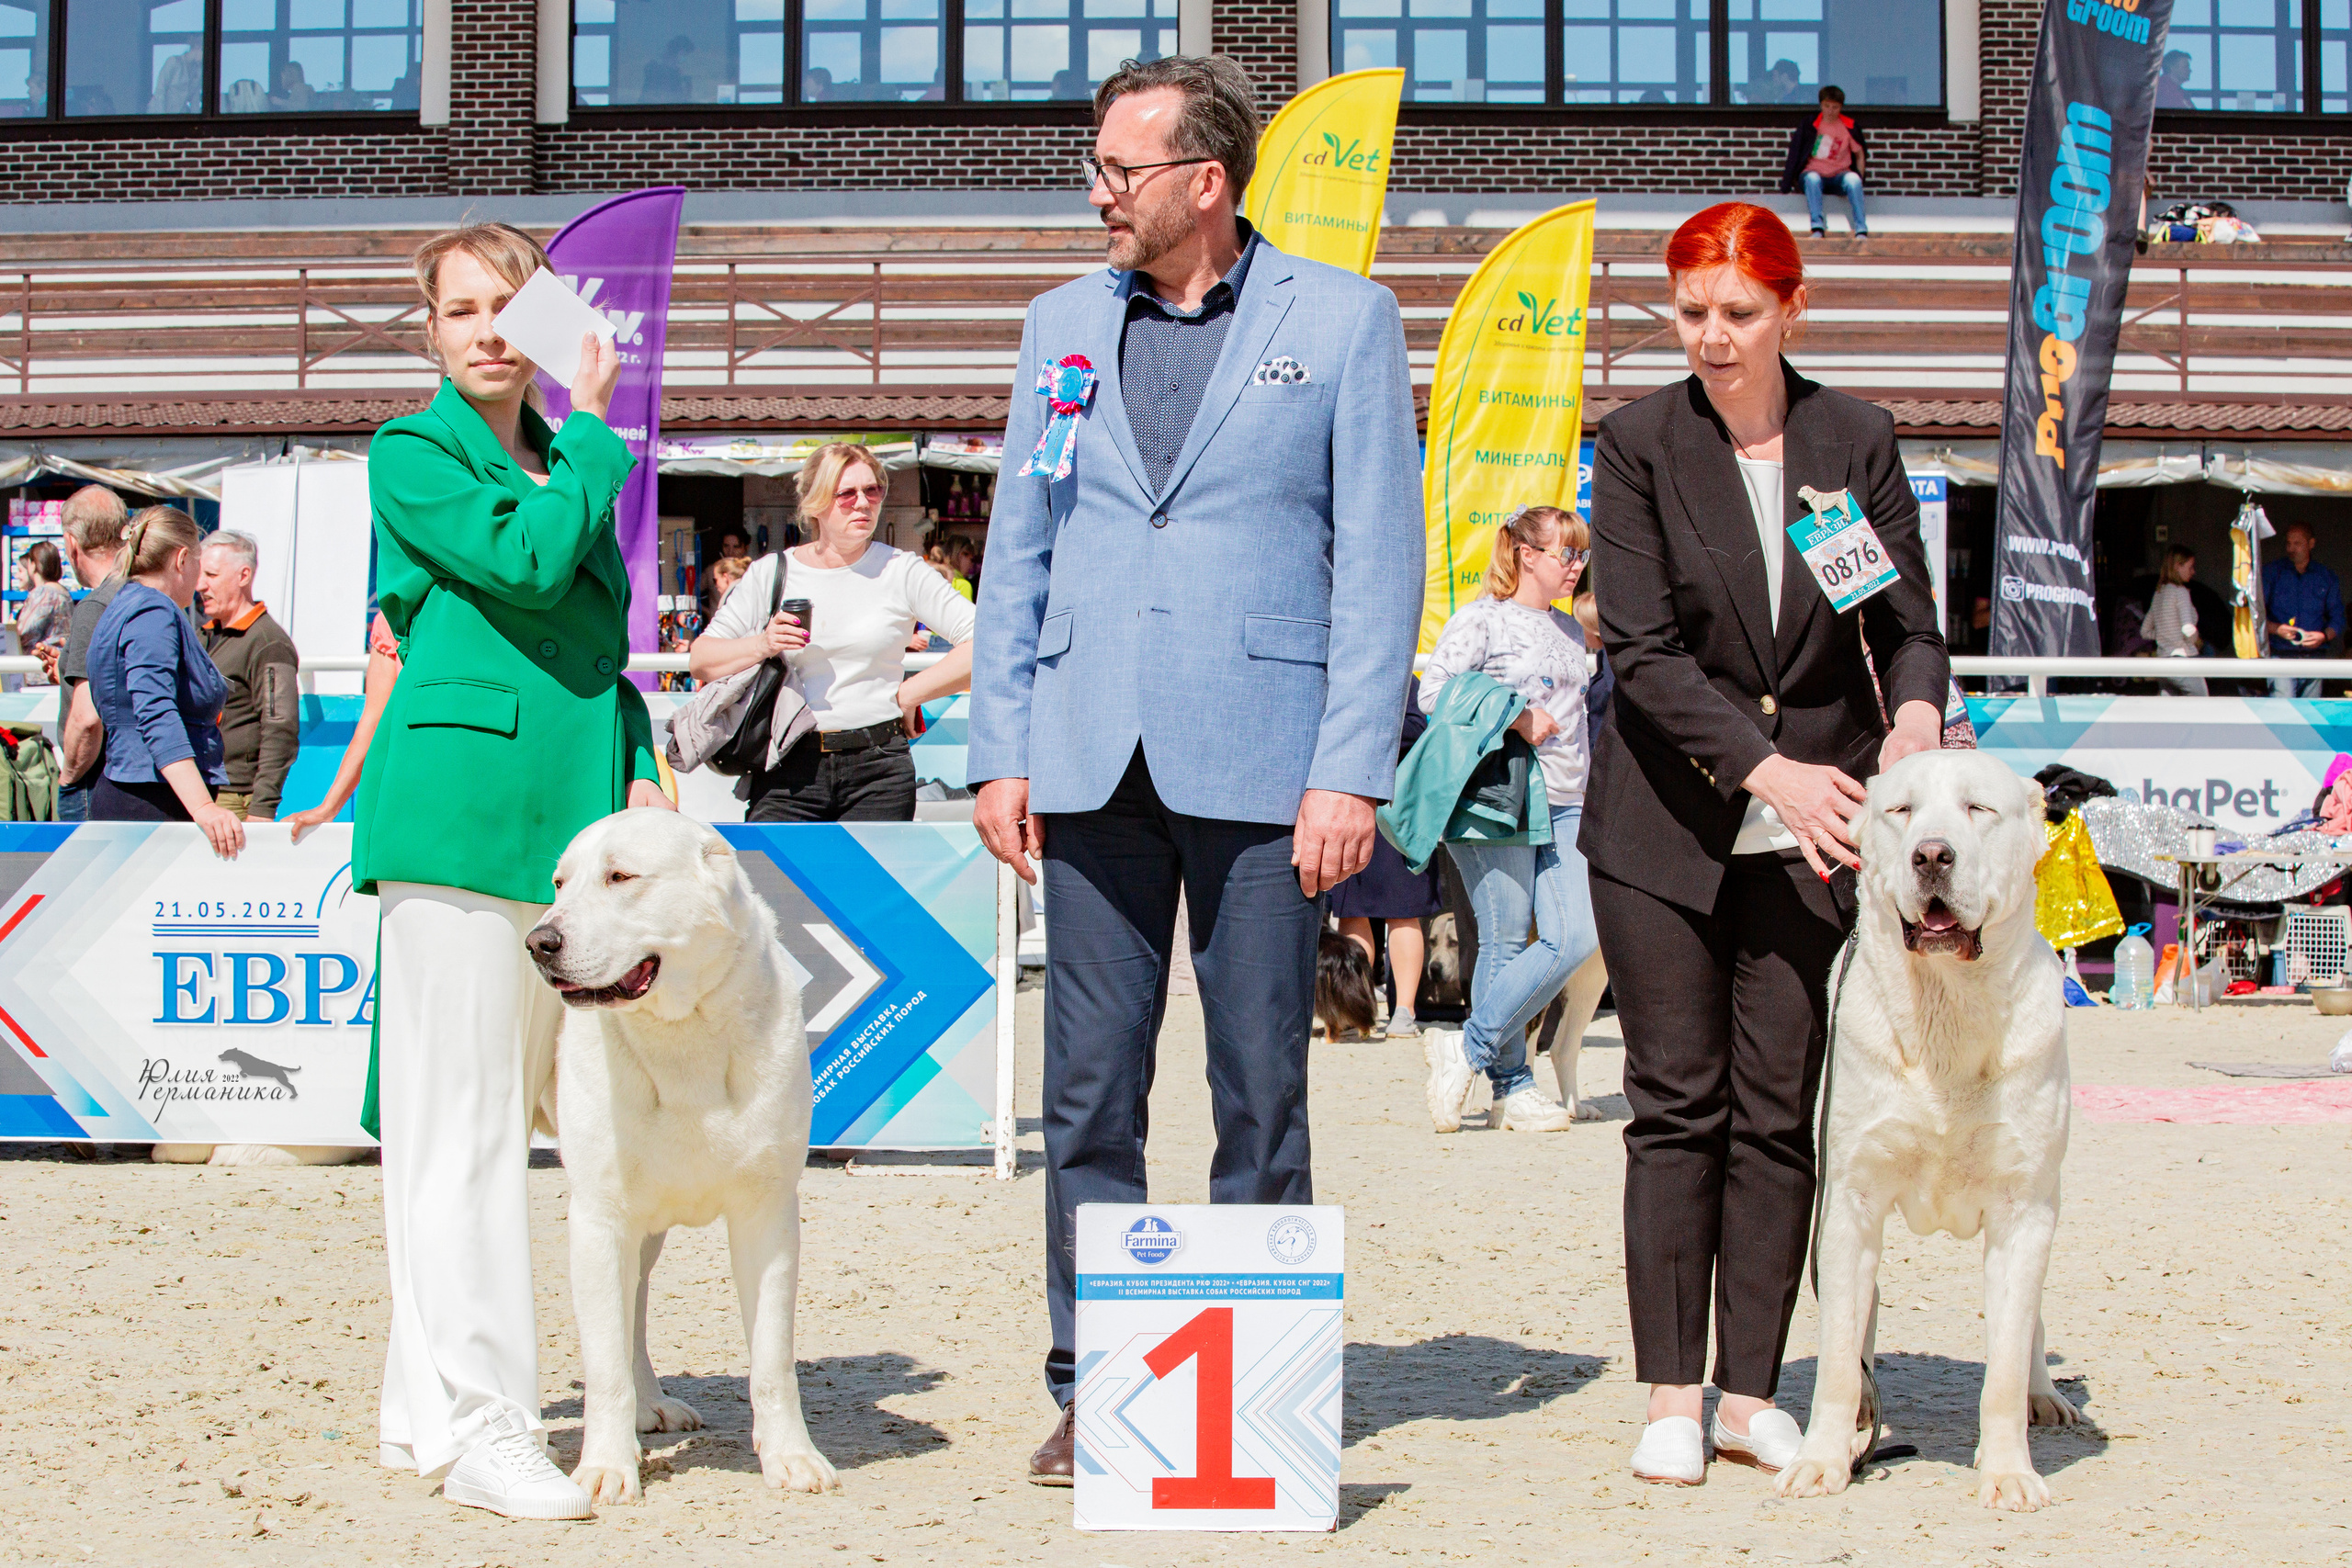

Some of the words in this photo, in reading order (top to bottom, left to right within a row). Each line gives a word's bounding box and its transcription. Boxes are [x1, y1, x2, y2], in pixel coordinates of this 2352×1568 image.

[1284, 212, 1369, 232] ВИТАМИНЫ
[1479, 390, 1576, 409] ВИТАМИНЫ
[1822, 541, 1879, 586] 0876
[1849, 579, 1881, 600] 21.05.2022
[2117, 778, 2279, 818] haPet
[154, 901, 304, 919] 21.05.2022
[851, 1003, 899, 1049] ВЫСТАВКА
[812, 1078, 838, 1108] ОБАК
[836, 1021, 895, 1079] РОССИЙСКИХ
[894, 990, 927, 1022] ПОРОД
[138, 1058, 218, 1083] Юлия
[221, 1074, 240, 1083] 2022
[1125, 1234, 1177, 1247] Farmina
[1148, 1250, 1165, 1258] Foods
[1150, 1280, 1194, 1288] ПРЕЗИДЕНТА
[1196, 1279, 1211, 1287] РКФ
[1229, 1287, 1275, 1295] РОССИЙСКИХ
[1142, 1307, 1275, 1509] 1
